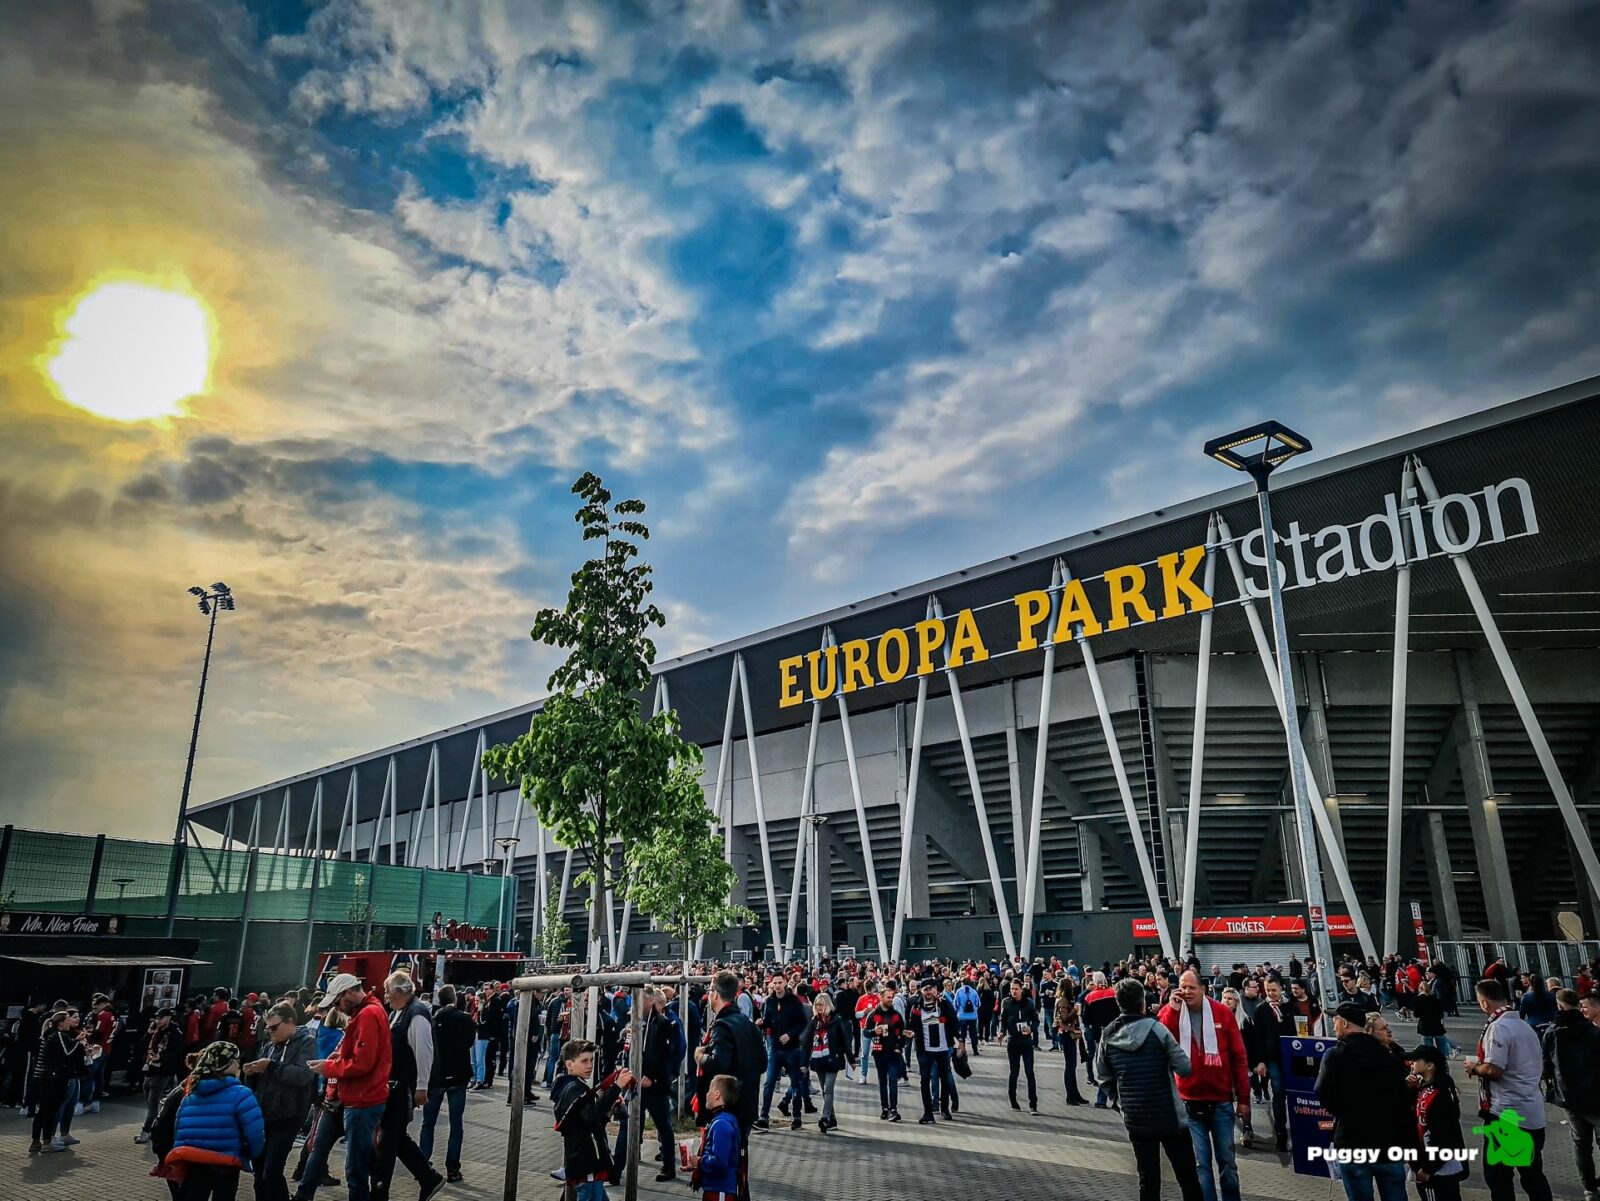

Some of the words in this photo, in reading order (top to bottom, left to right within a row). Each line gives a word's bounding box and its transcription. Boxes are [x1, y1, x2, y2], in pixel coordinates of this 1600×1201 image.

[779, 608, 989, 709] EUROPA
[1014, 545, 1214, 652] PARK
[1241, 477, 1539, 598] Stadion
[20, 916, 43, 932] Mr.
[45, 916, 71, 932] Nice
[72, 917, 99, 933] Fries
[1135, 922, 1157, 931] FANBÜ
[1226, 921, 1265, 934] TICKETS
[1296, 1097, 1308, 1105] Das
